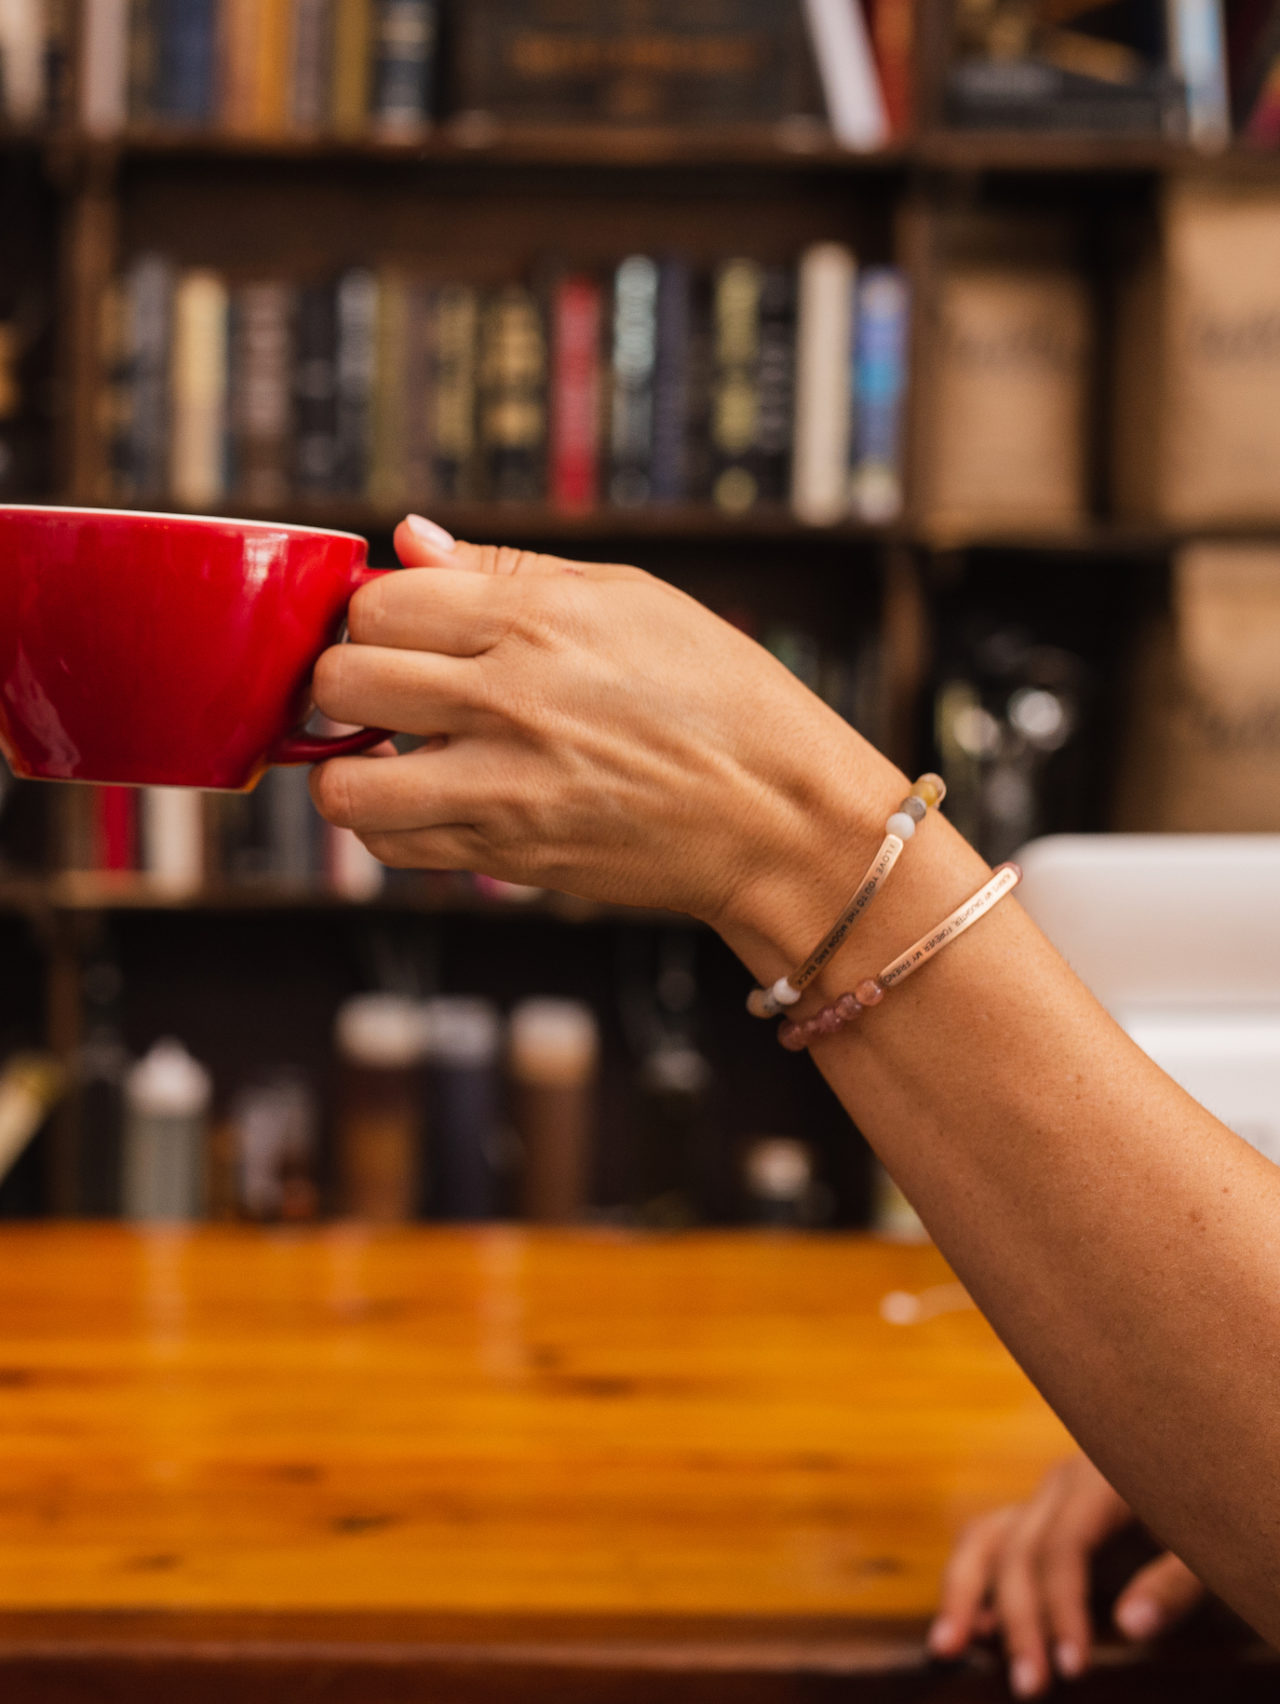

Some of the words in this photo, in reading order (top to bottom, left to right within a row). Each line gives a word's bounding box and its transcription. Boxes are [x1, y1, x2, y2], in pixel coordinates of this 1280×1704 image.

[876, 849, 893, 875] LOVE
[864, 874, 880, 895] YOU
[855, 892, 869, 908] TO
[846, 907, 860, 925] THE
[827, 923, 849, 950] MOON
[923, 926, 953, 952] FOREVER
[910, 950, 924, 963] MY
[883, 960, 911, 984] FRIEND
